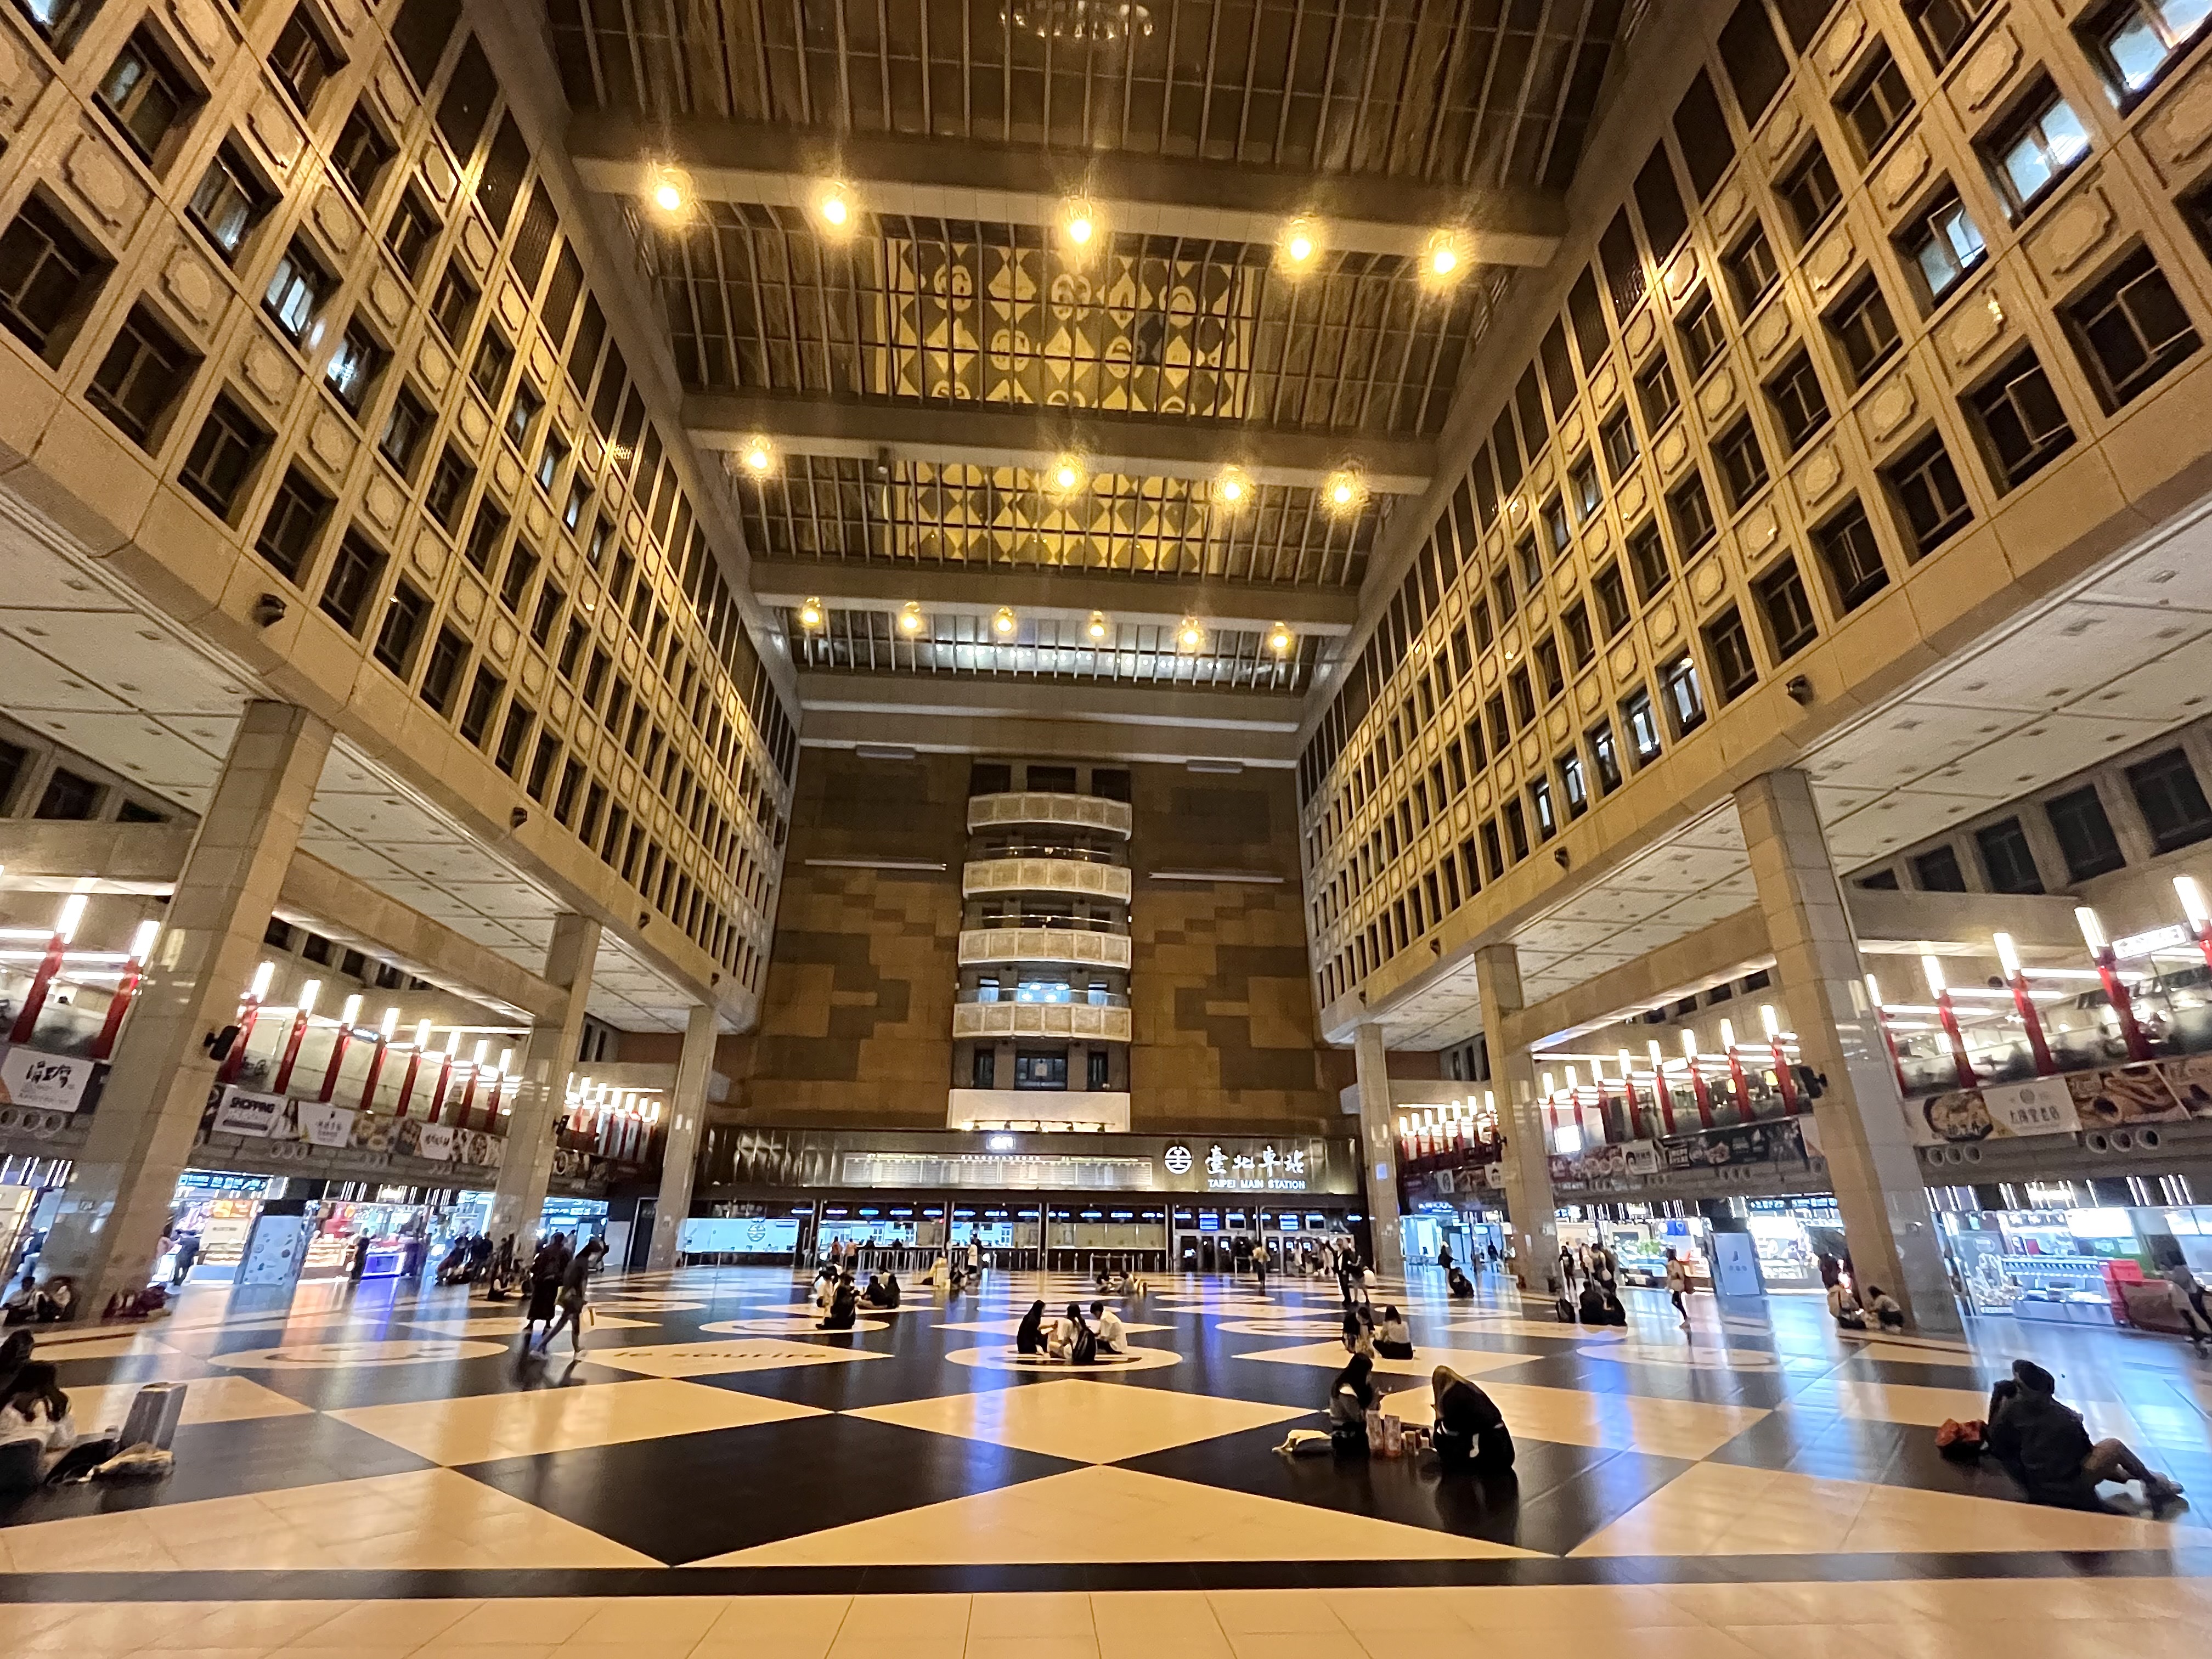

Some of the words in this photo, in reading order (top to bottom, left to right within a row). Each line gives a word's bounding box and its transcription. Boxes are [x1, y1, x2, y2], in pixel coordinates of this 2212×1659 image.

[1205, 1144, 1305, 1177] 臺北車站
[1208, 1179, 1235, 1188] TAIPEI
[1240, 1180, 1263, 1188] MAIN
[1268, 1180, 1305, 1189] STATION
